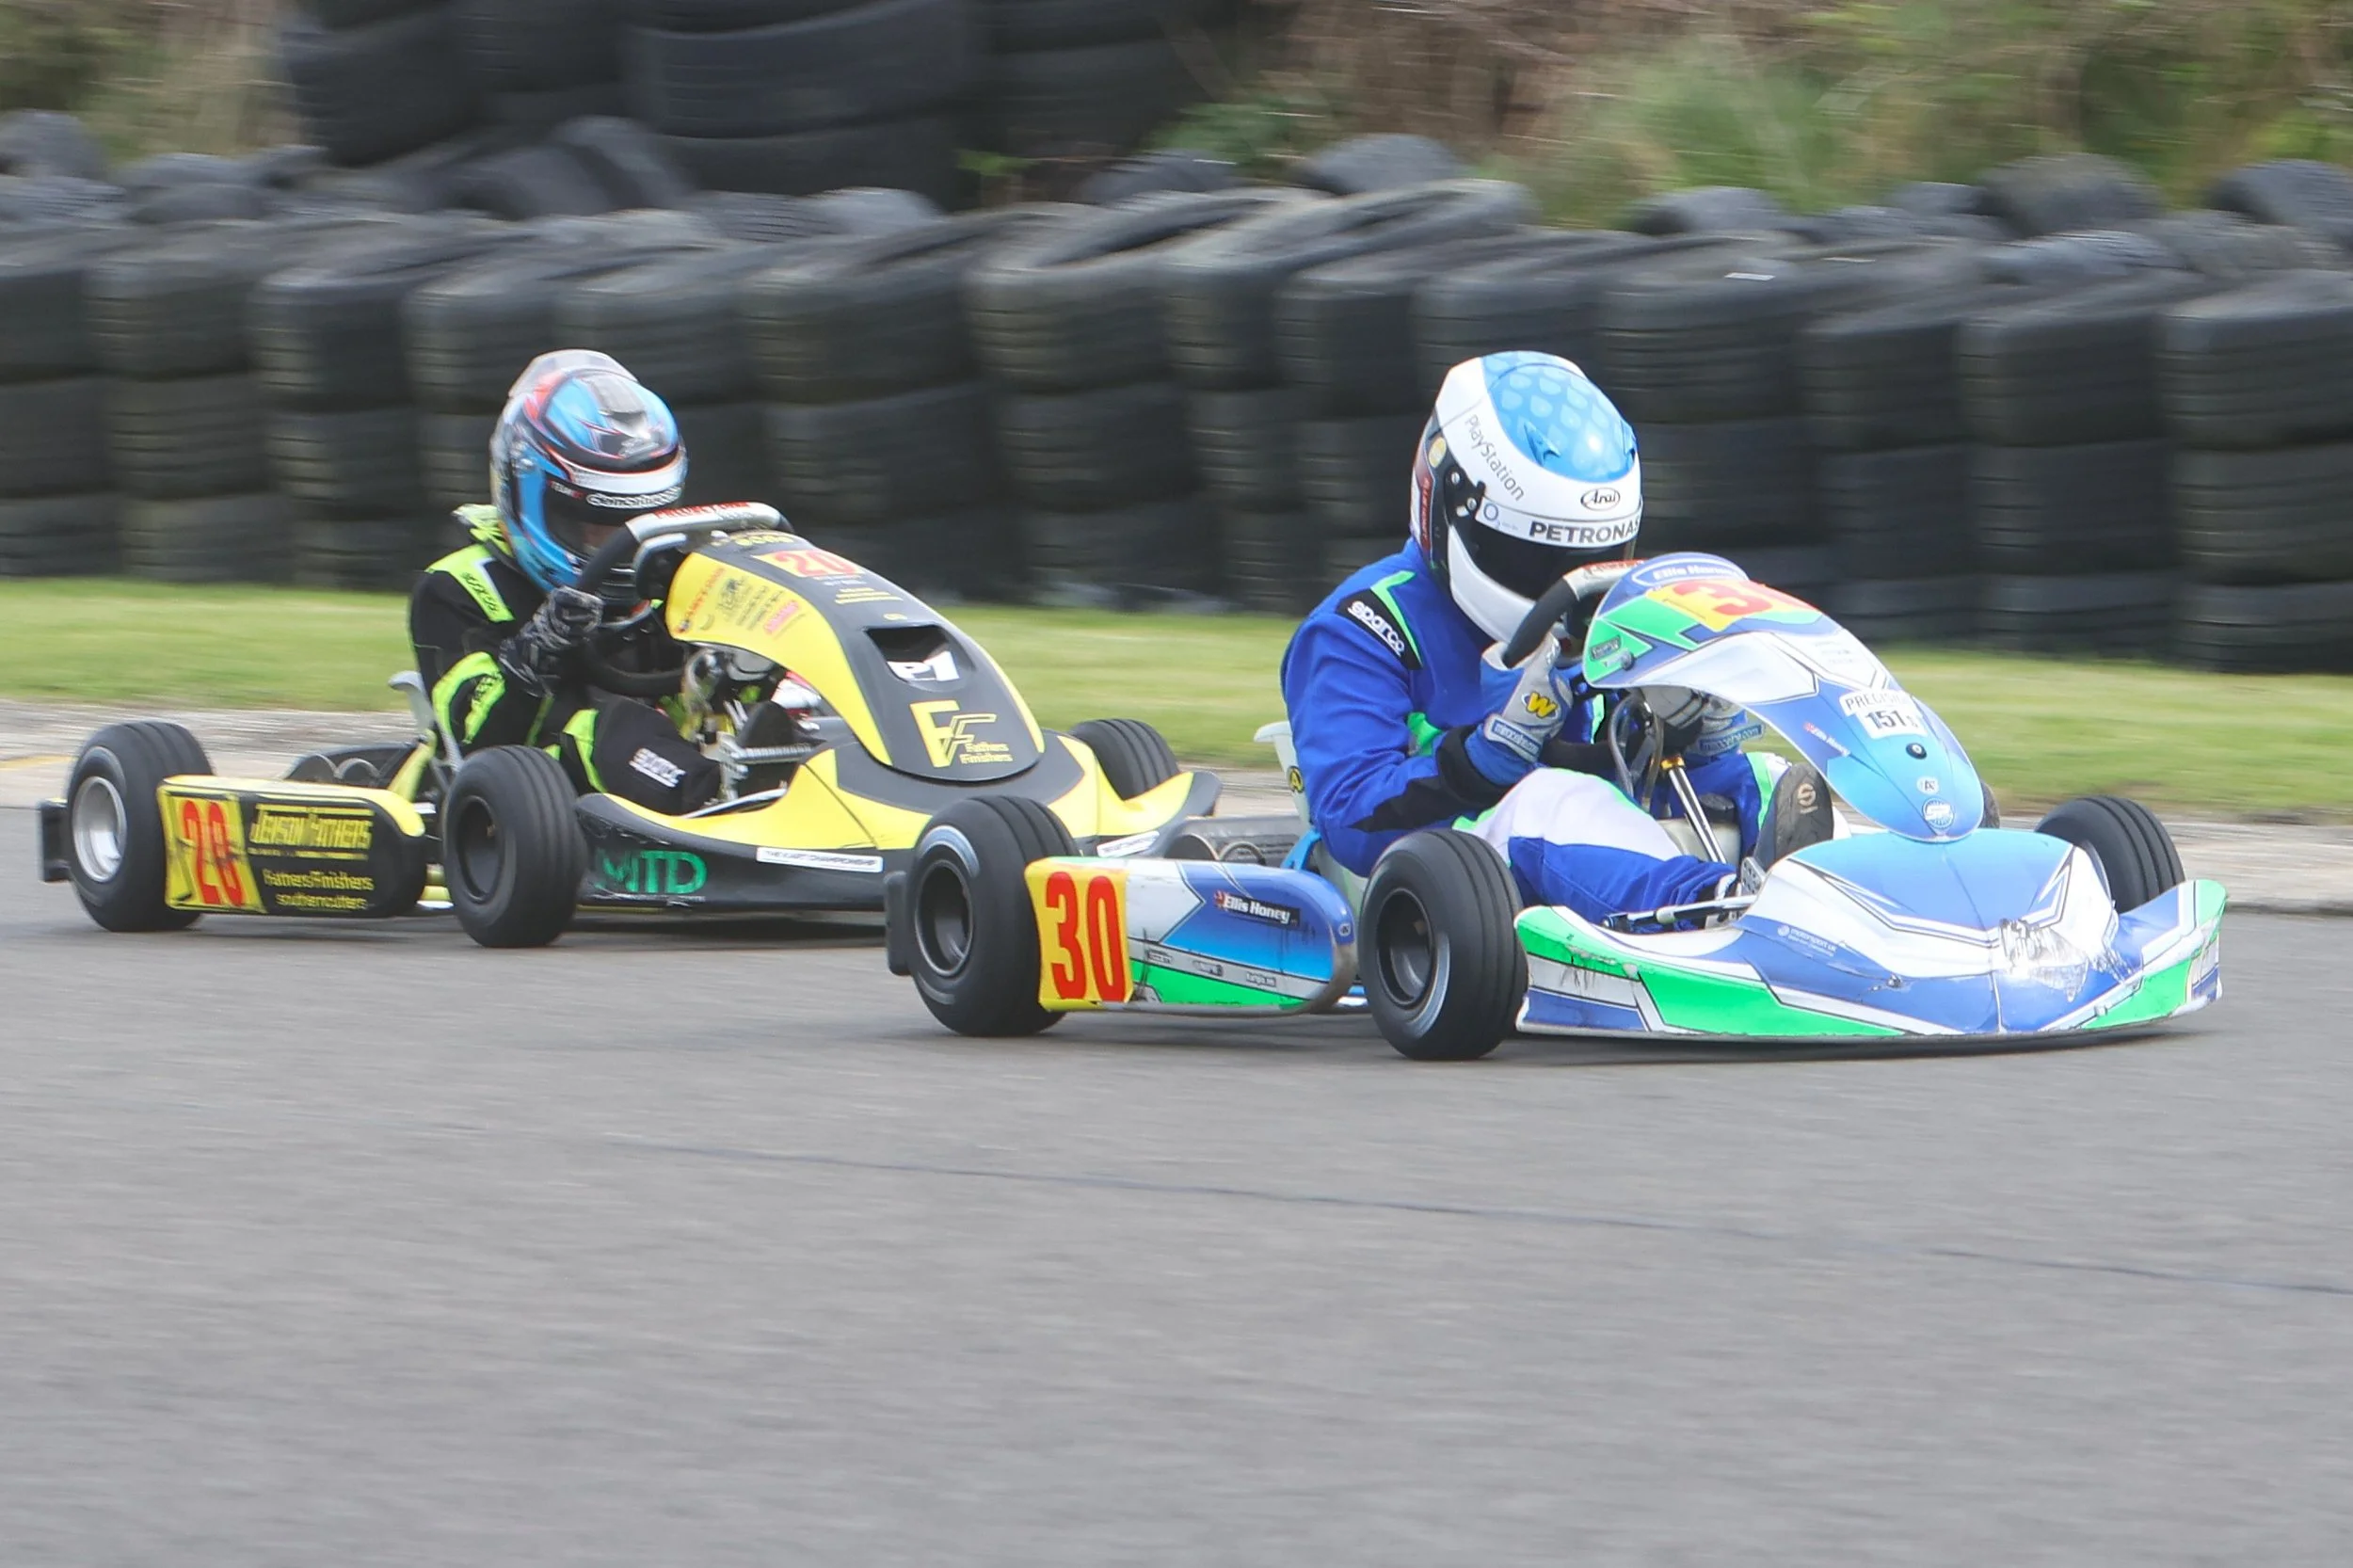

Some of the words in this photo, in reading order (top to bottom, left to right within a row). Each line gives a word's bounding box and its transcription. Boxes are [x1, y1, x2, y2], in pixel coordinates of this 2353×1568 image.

[1465, 414, 1525, 502] PlayStation
[1584, 488, 1618, 506] Arai
[1865, 709, 1908, 730] 151
[1224, 894, 1249, 914] Ellis
[1249, 900, 1291, 925] Honey
[1046, 872, 1127, 1002] 30
